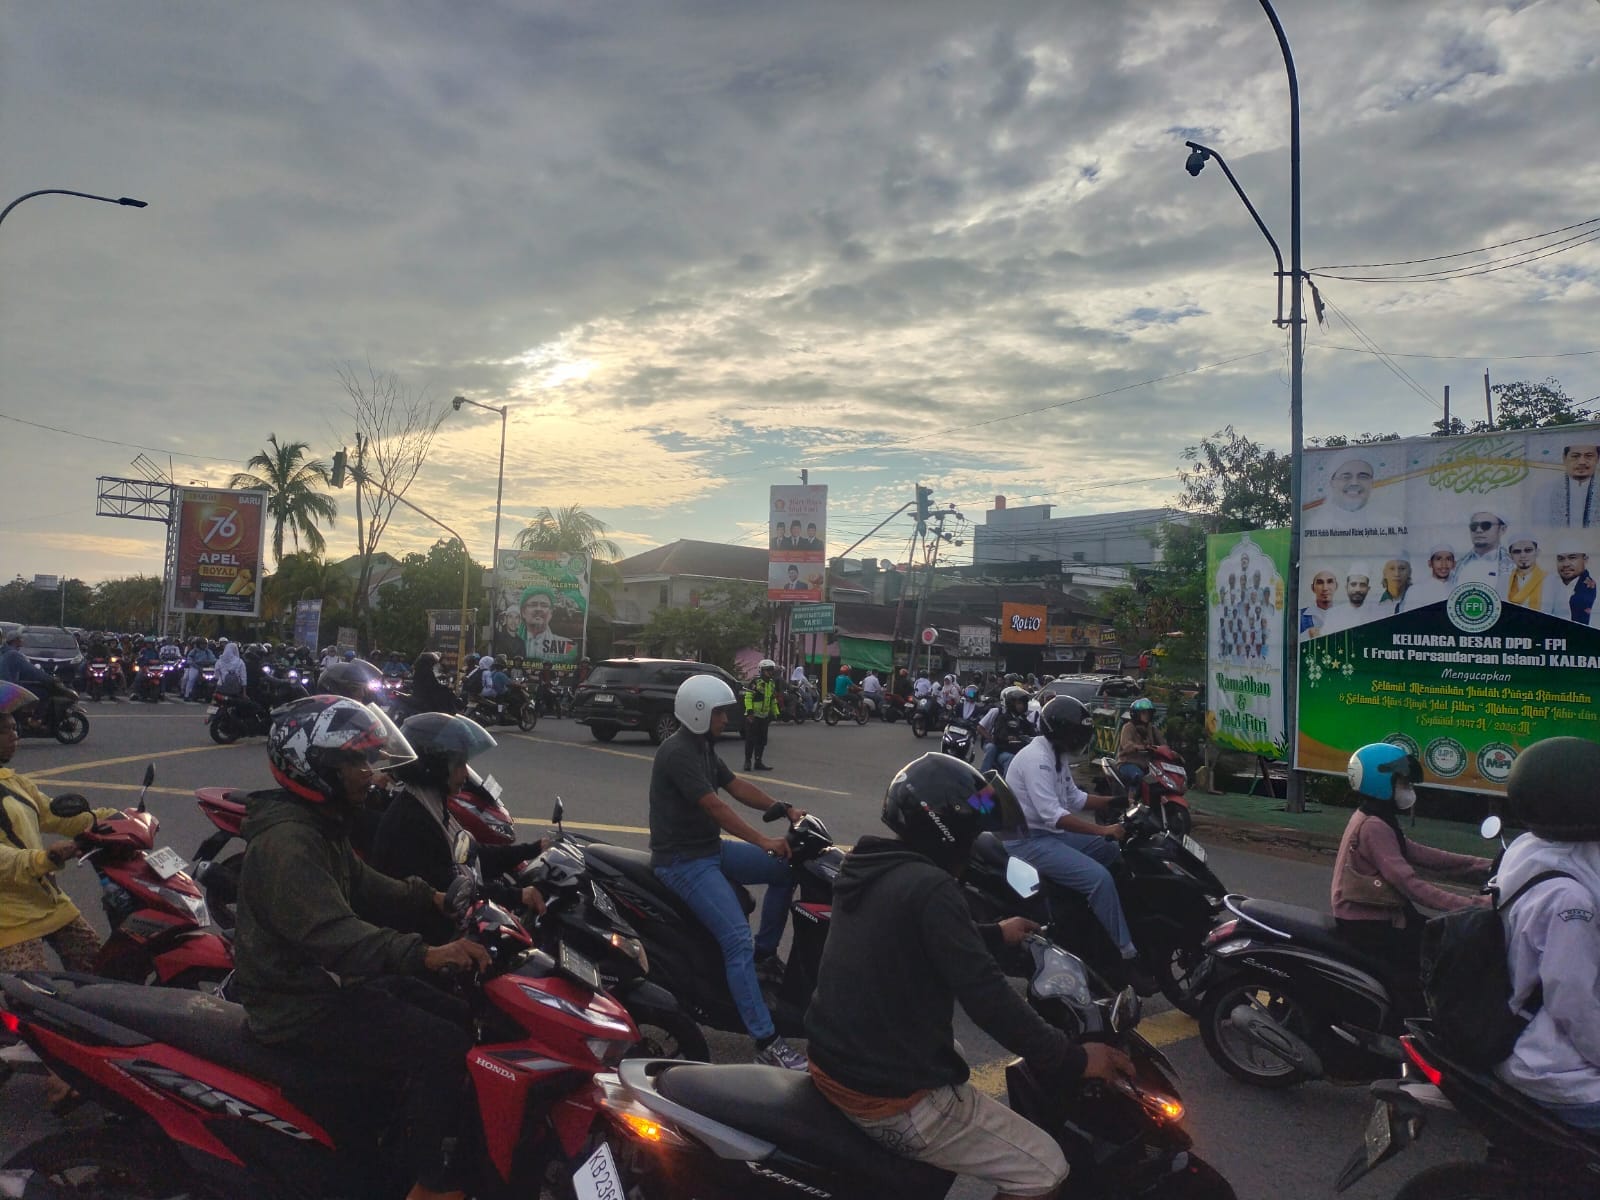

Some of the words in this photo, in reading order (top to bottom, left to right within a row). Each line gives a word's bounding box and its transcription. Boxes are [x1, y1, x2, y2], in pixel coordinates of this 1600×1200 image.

[203, 509, 238, 544] 76
[199, 552, 241, 565] APEL
[202, 566, 235, 576] ROYAL
[1466, 602, 1483, 611] FPI
[1392, 633, 1456, 647] KELUARGA
[1459, 636, 1501, 649] BESAR
[1505, 637, 1532, 650] DPD
[1544, 638, 1567, 651] FPI
[1407, 649, 1499, 664] Persaudaraan
[1502, 652, 1546, 667] Islam)
[1441, 668, 1511, 683] Mengucapkan
[1216, 672, 1271, 698] Ramadhan
[1371, 680, 1406, 692] Selamat
[1409, 682, 1464, 696] Menunaikan
[1465, 686, 1500, 699] Ibadah
[1501, 687, 1534, 702] Puasa
[1535, 689, 1592, 704] Ramadhan
[1238, 694, 1247, 712] &
[1346, 692, 1380, 705] Selamat
[1429, 698, 1448, 712] Idul
[1485, 702, 1519, 716] Mohon
[1521, 705, 1551, 719] Maaf
[1219, 708, 1241, 729] Idul
[1242, 713, 1268, 735] Fitri
[794, 905, 819, 924] HONDA
[475, 1056, 516, 1081] HONDA
